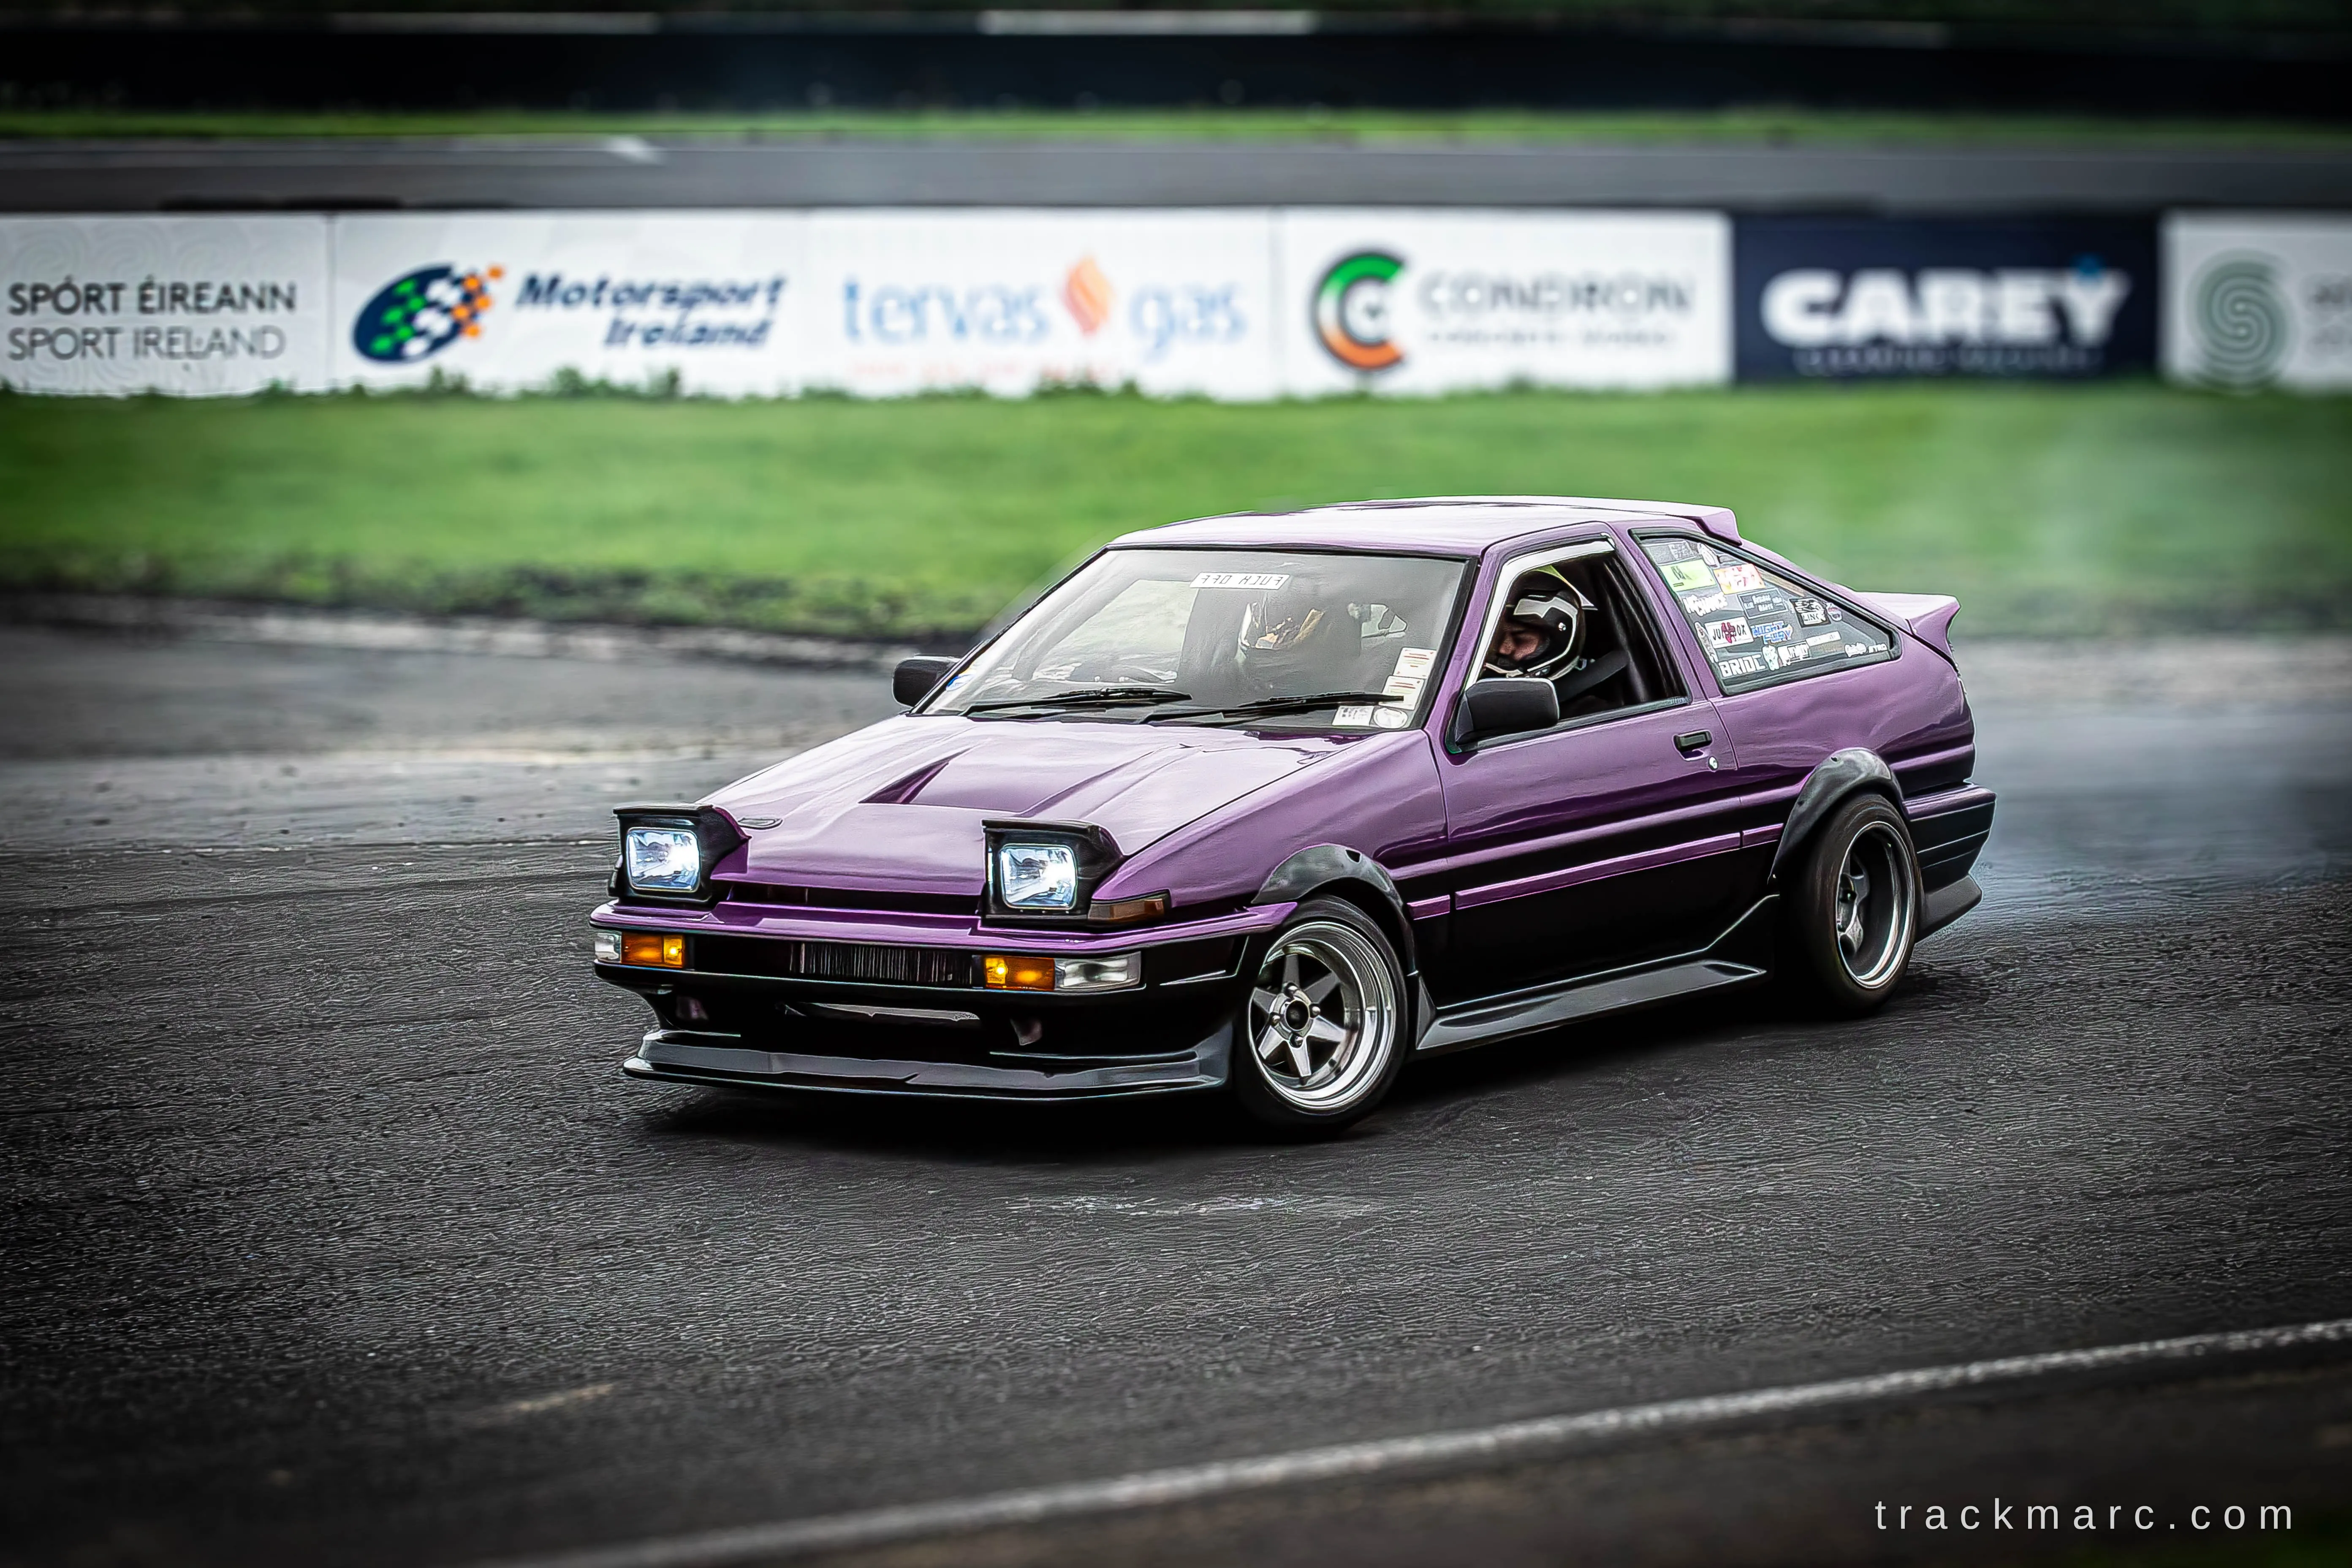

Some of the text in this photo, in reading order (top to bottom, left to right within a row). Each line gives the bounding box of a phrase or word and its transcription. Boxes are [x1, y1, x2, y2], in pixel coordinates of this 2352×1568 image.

[7, 275, 296, 316] SPÓRT ÉIREANN
[515, 272, 786, 320] Motorsport
[1419, 271, 1696, 317] CONDRON
[1760, 267, 2130, 345] CAREY
[603, 317, 774, 348] Ireland
[842, 275, 1247, 365] tervas gas
[7, 326, 286, 361] SPORT IRELAND
